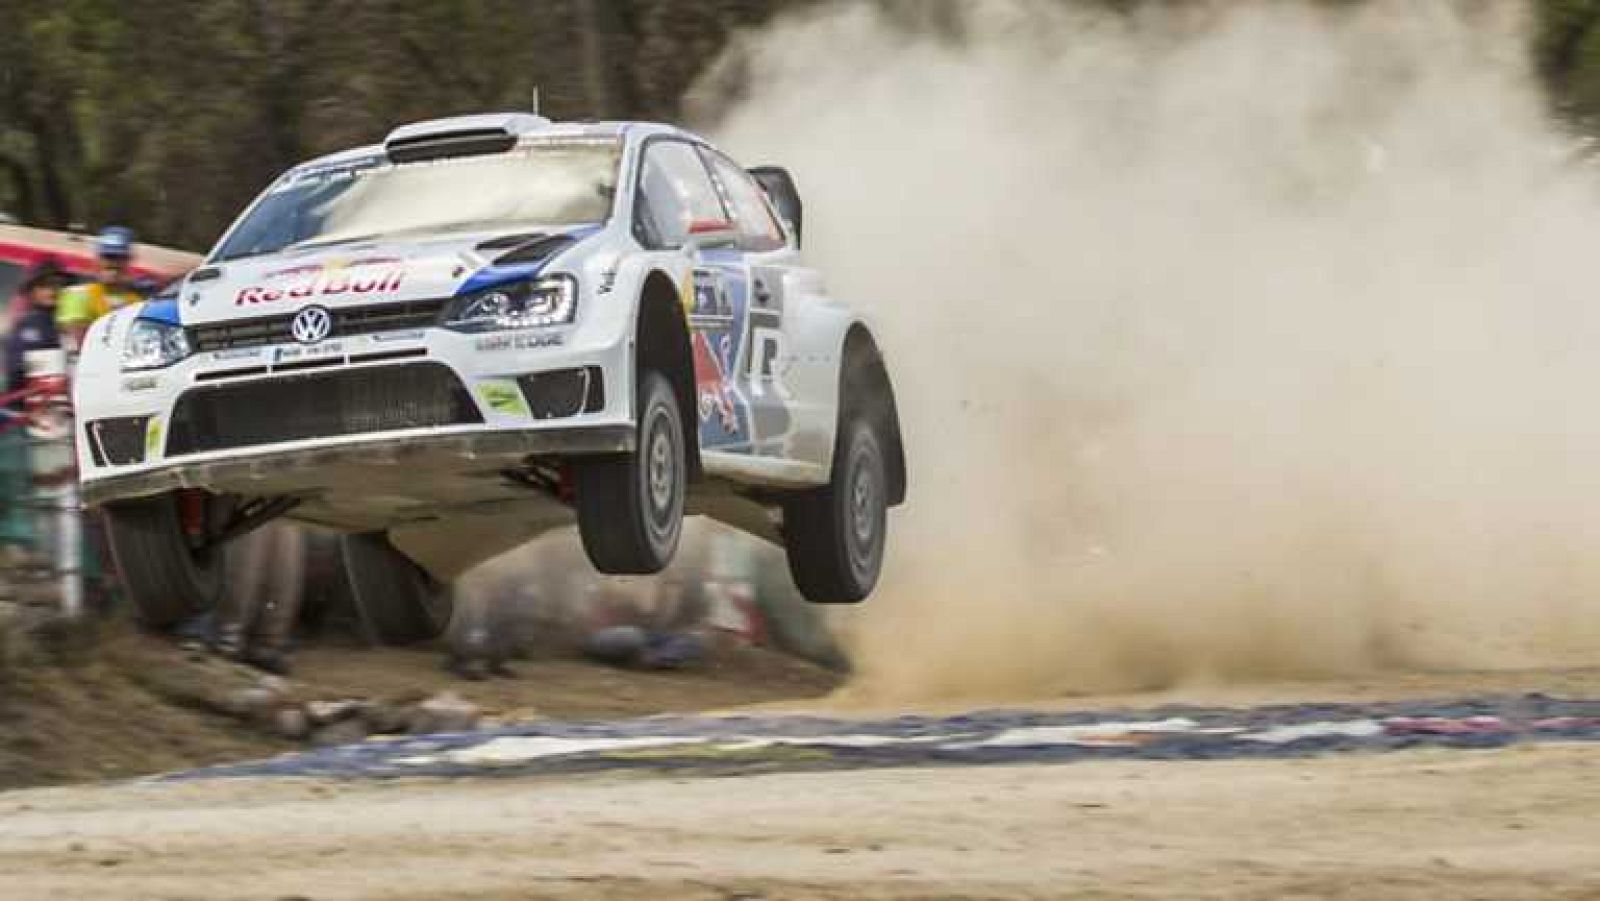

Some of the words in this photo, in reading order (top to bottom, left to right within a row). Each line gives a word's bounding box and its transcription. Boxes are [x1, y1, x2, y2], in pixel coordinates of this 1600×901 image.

[235, 279, 315, 306] Red
[321, 269, 404, 296] Bull
[294, 307, 330, 342] VW
